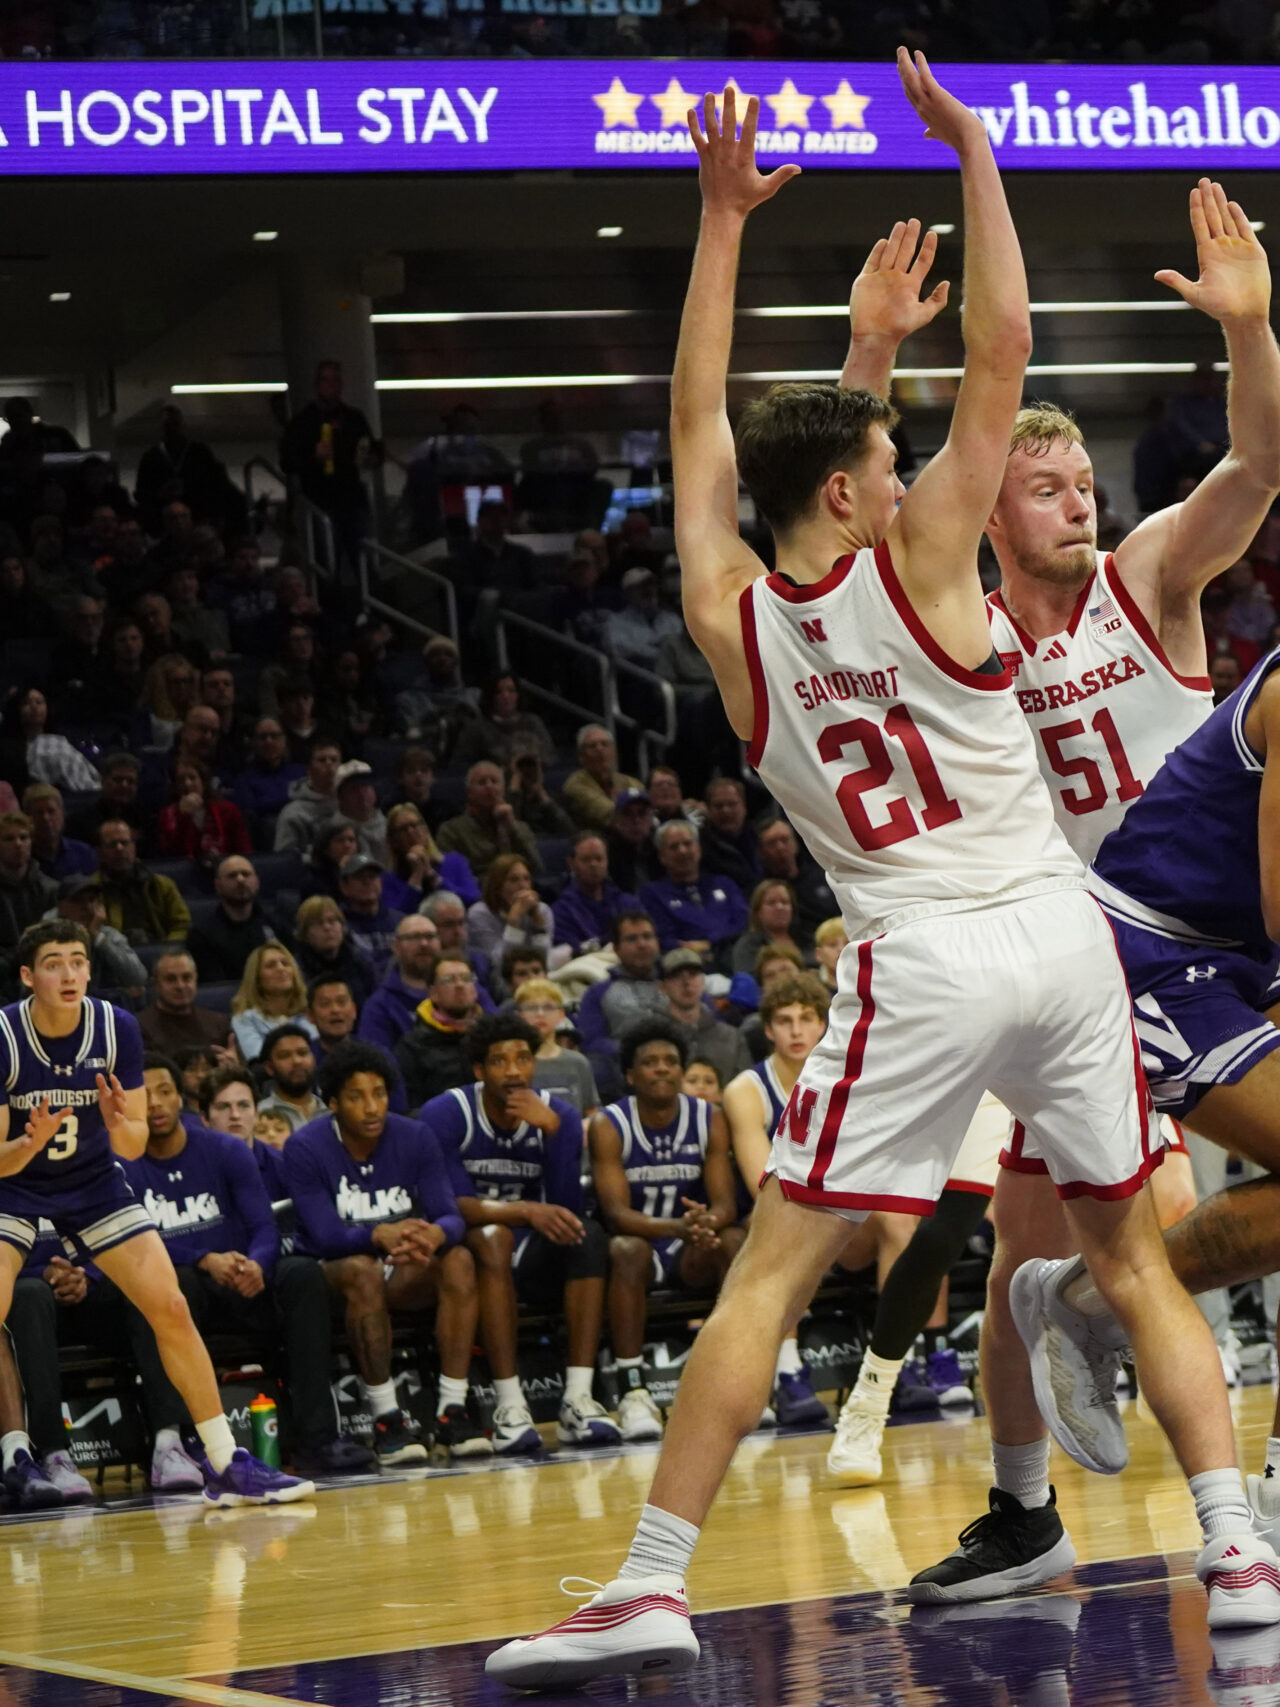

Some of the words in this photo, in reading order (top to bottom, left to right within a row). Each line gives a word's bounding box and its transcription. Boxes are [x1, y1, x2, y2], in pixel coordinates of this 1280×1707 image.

[27, 89, 343, 147] HOSPITAL
[358, 87, 499, 144] STAY
[595, 131, 709, 153] MEDICA
[804, 131, 878, 154] RATED
[801, 618, 828, 644] N
[794, 666, 899, 711] SANDFORT
[1013, 654, 1146, 715] EBRASKA
[816, 702, 963, 852] 21
[1039, 707, 1144, 817] 51
[48, 1114, 79, 1161] 3
[776, 1081, 822, 1147] N
[642, 1186, 678, 1218] 11
